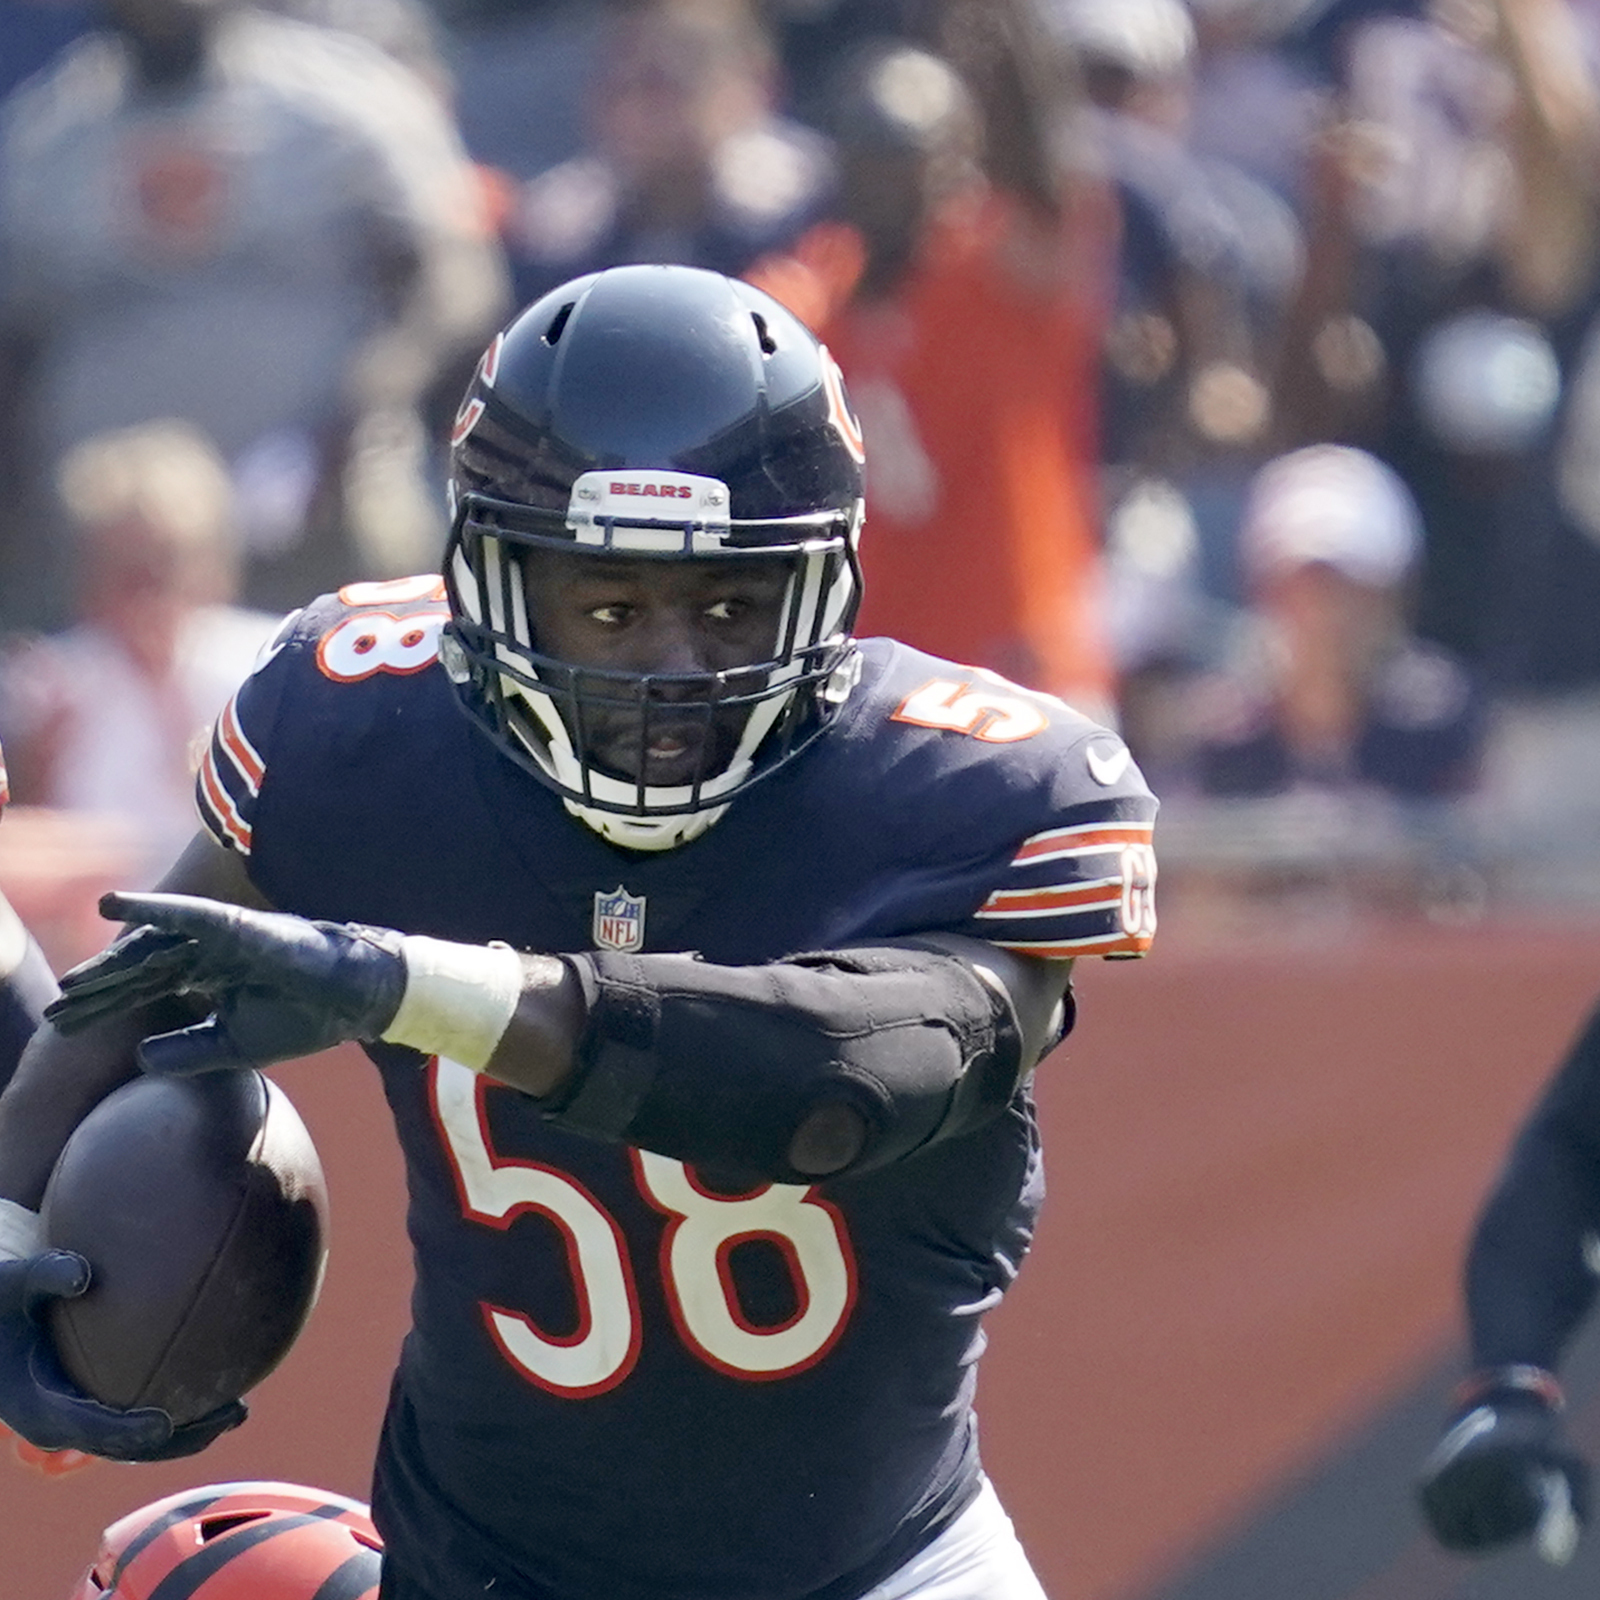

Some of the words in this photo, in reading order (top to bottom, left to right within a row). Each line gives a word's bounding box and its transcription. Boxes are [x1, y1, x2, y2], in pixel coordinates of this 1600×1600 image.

[609, 482, 693, 499] BEARS
[601, 918, 636, 945] NFL
[426, 1052, 860, 1400] 58
